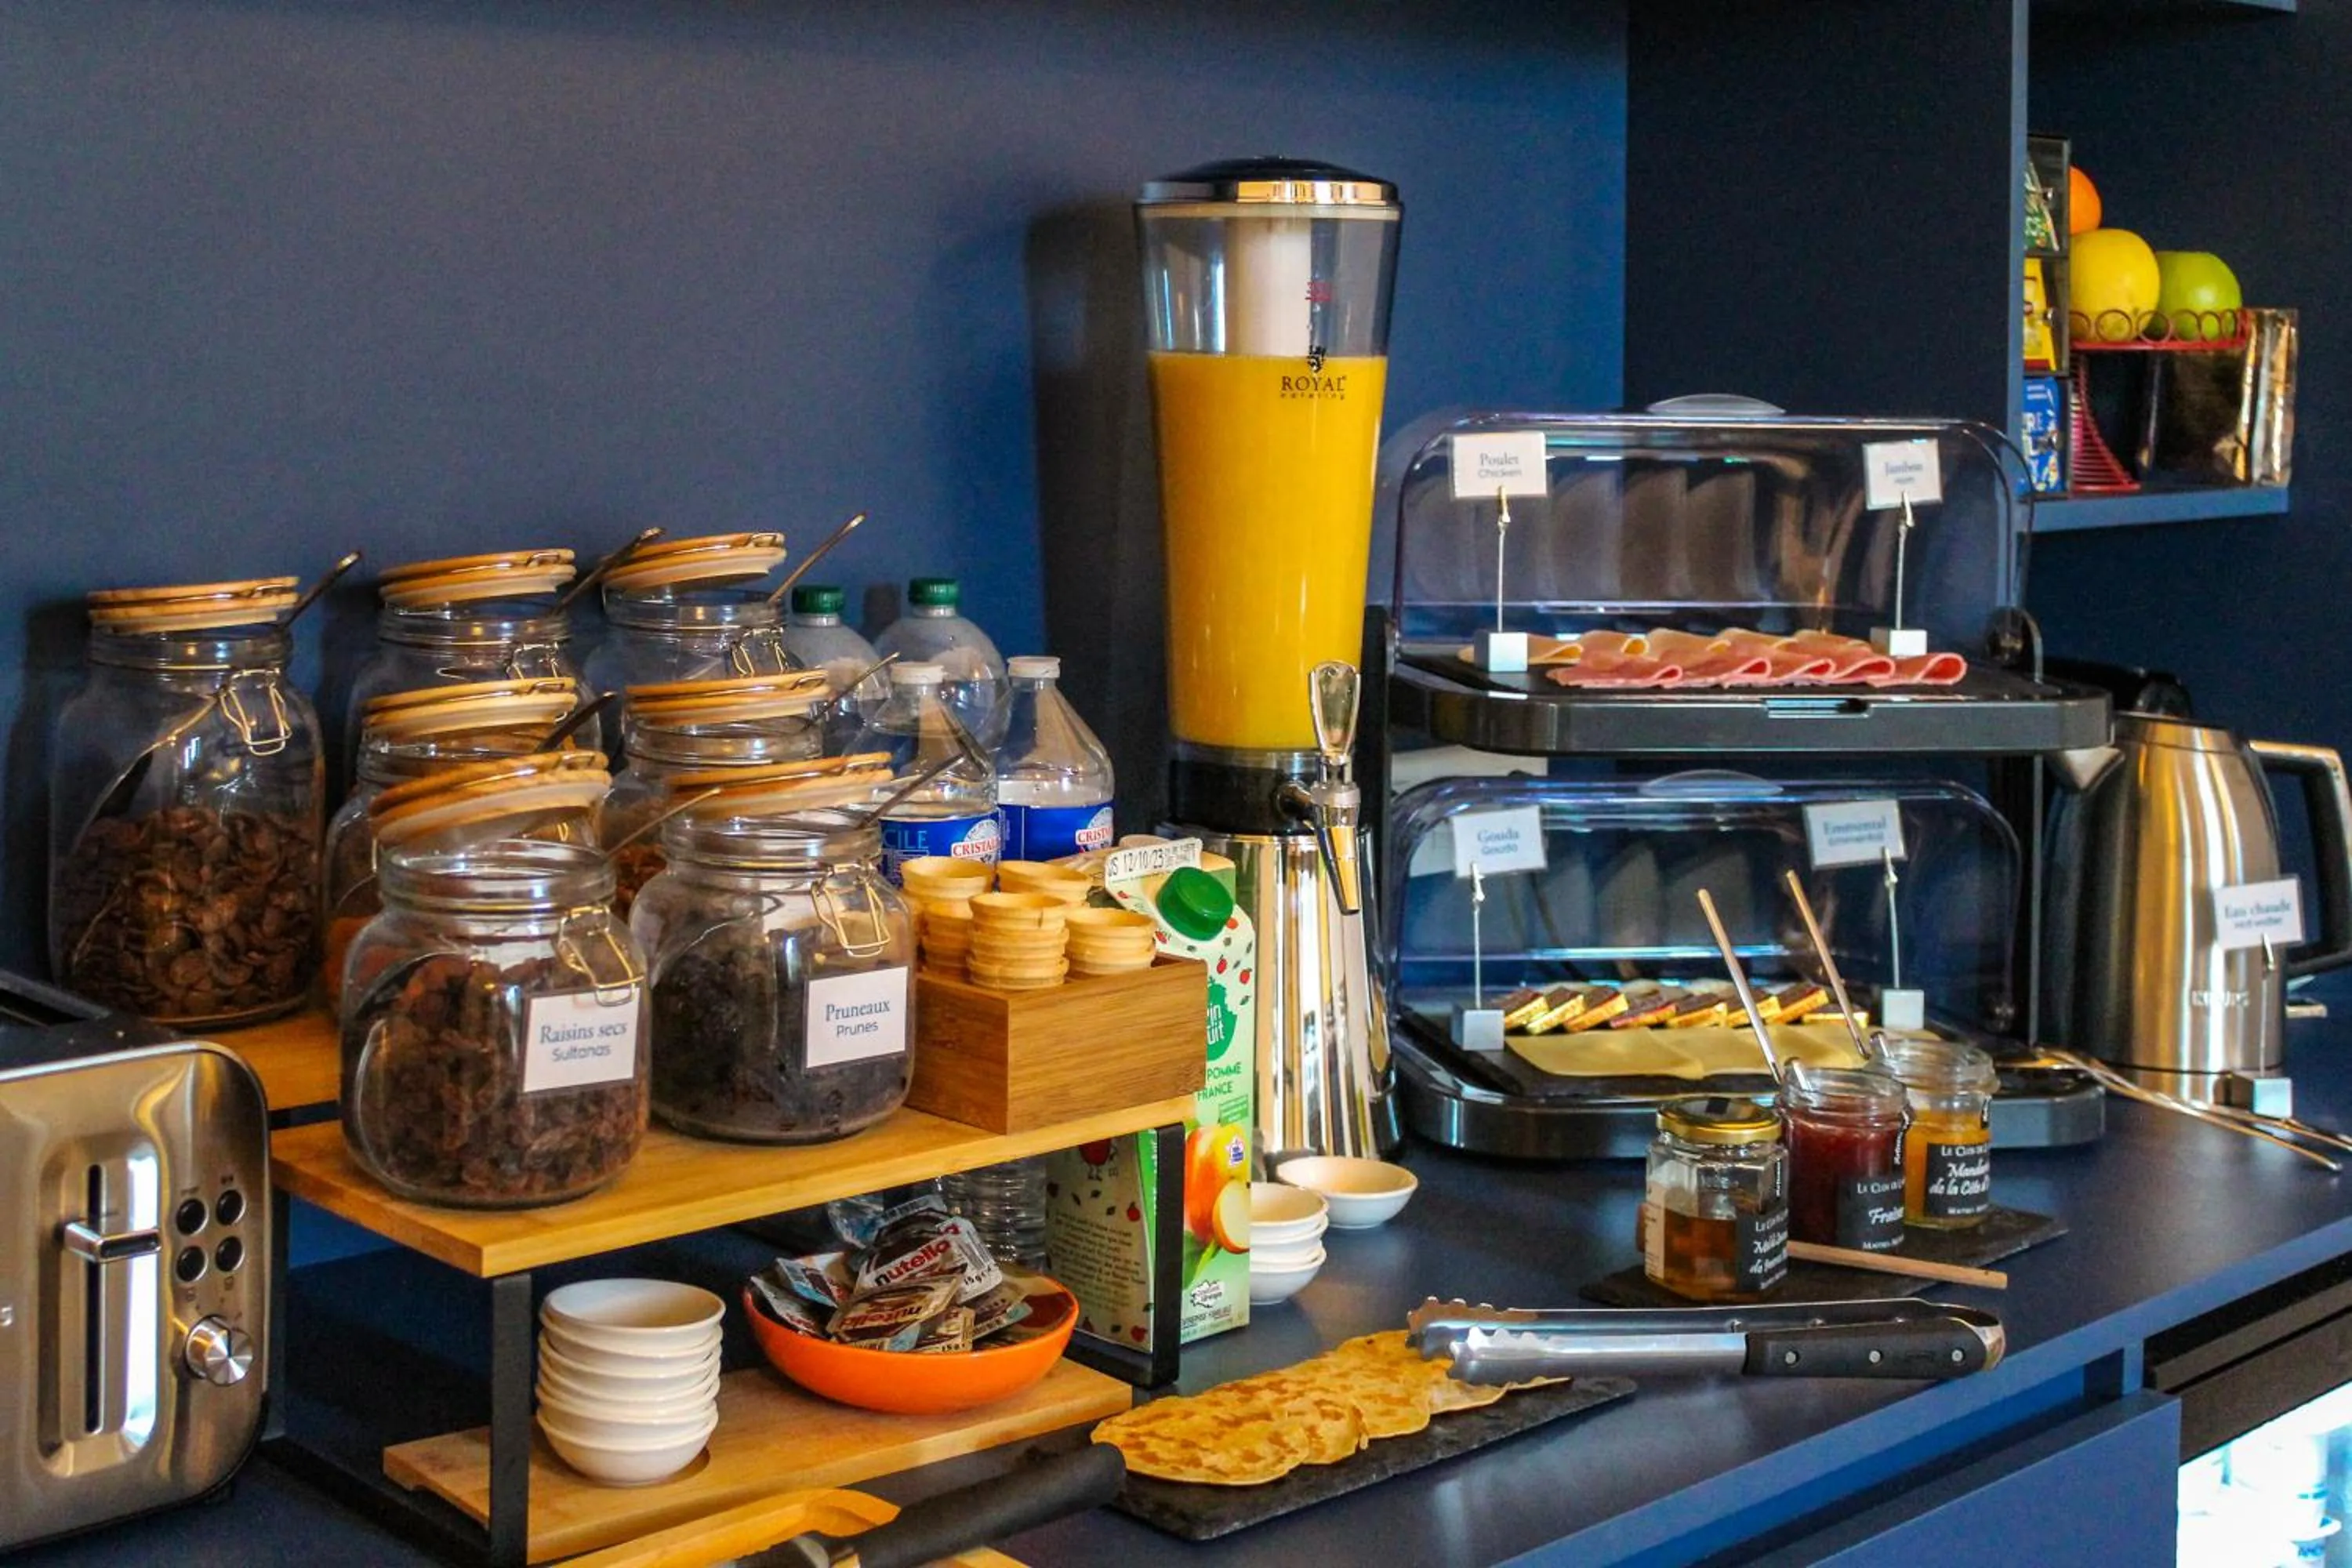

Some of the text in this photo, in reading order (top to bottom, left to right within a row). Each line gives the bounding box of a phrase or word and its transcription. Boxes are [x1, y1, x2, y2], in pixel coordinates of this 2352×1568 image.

[1281, 376, 1346, 391] ROYAL
[1479, 452, 1519, 466] Poulet
[1477, 828, 1519, 843] Gouda
[826, 1000, 891, 1022] Pruneaux
[539, 1022, 627, 1044] Raisins secs
[836, 1022, 879, 1038] Prunes
[552, 1045, 611, 1062] Sultanas
[1207, 1062, 1242, 1080] POMME
[875, 1240, 951, 1287] nutella
